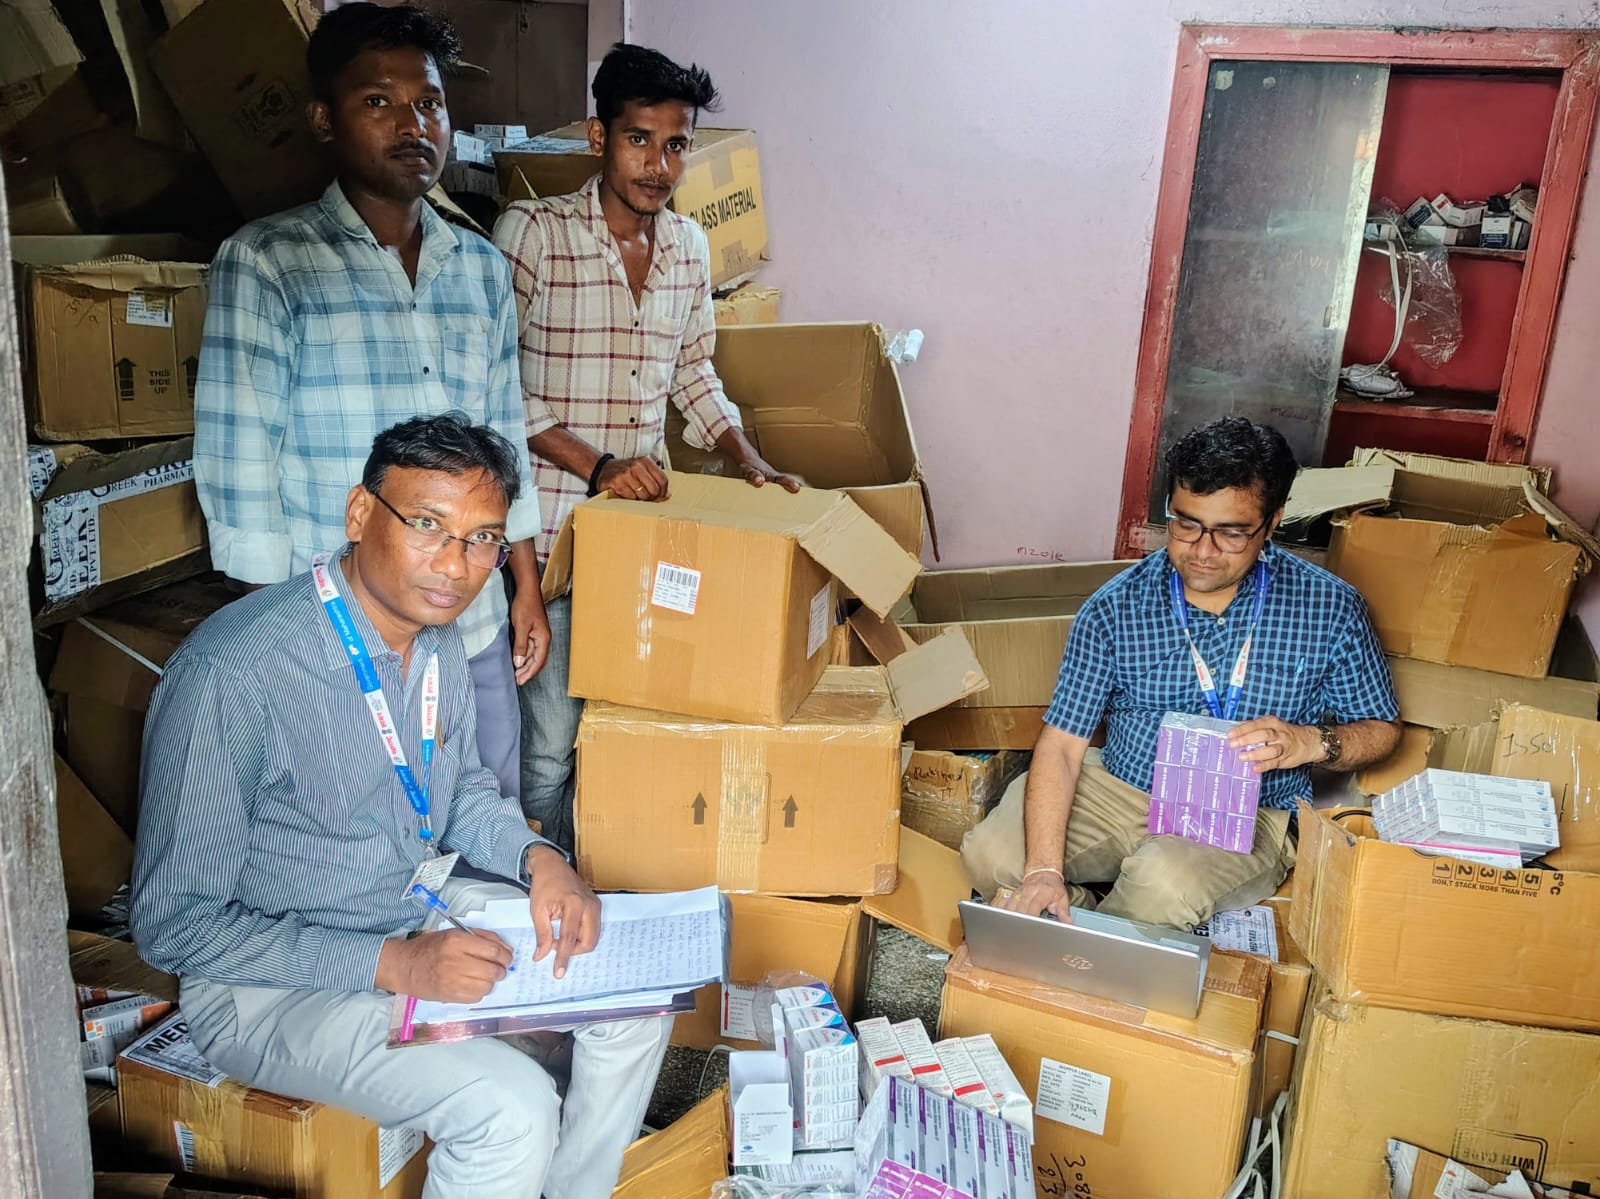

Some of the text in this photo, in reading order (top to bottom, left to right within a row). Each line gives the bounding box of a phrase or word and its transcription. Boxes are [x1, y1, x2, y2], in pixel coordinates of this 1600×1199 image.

[718, 186, 756, 224] MATERIAL
[154, 386, 167, 394] UP
[143, 469, 185, 489] PHARMA
[1458, 865, 1473, 875] 2
[1480, 867, 1495, 878] 3
[1502, 870, 1517, 881] 4
[1525, 873, 1540, 884] 5
[1455, 880, 1478, 890] STACK
[1480, 884, 1499, 892] MORE
[1501, 887, 1520, 896] THAN
[1521, 888, 1538, 898] FIVE
[1501, 1153, 1535, 1170] WITH
